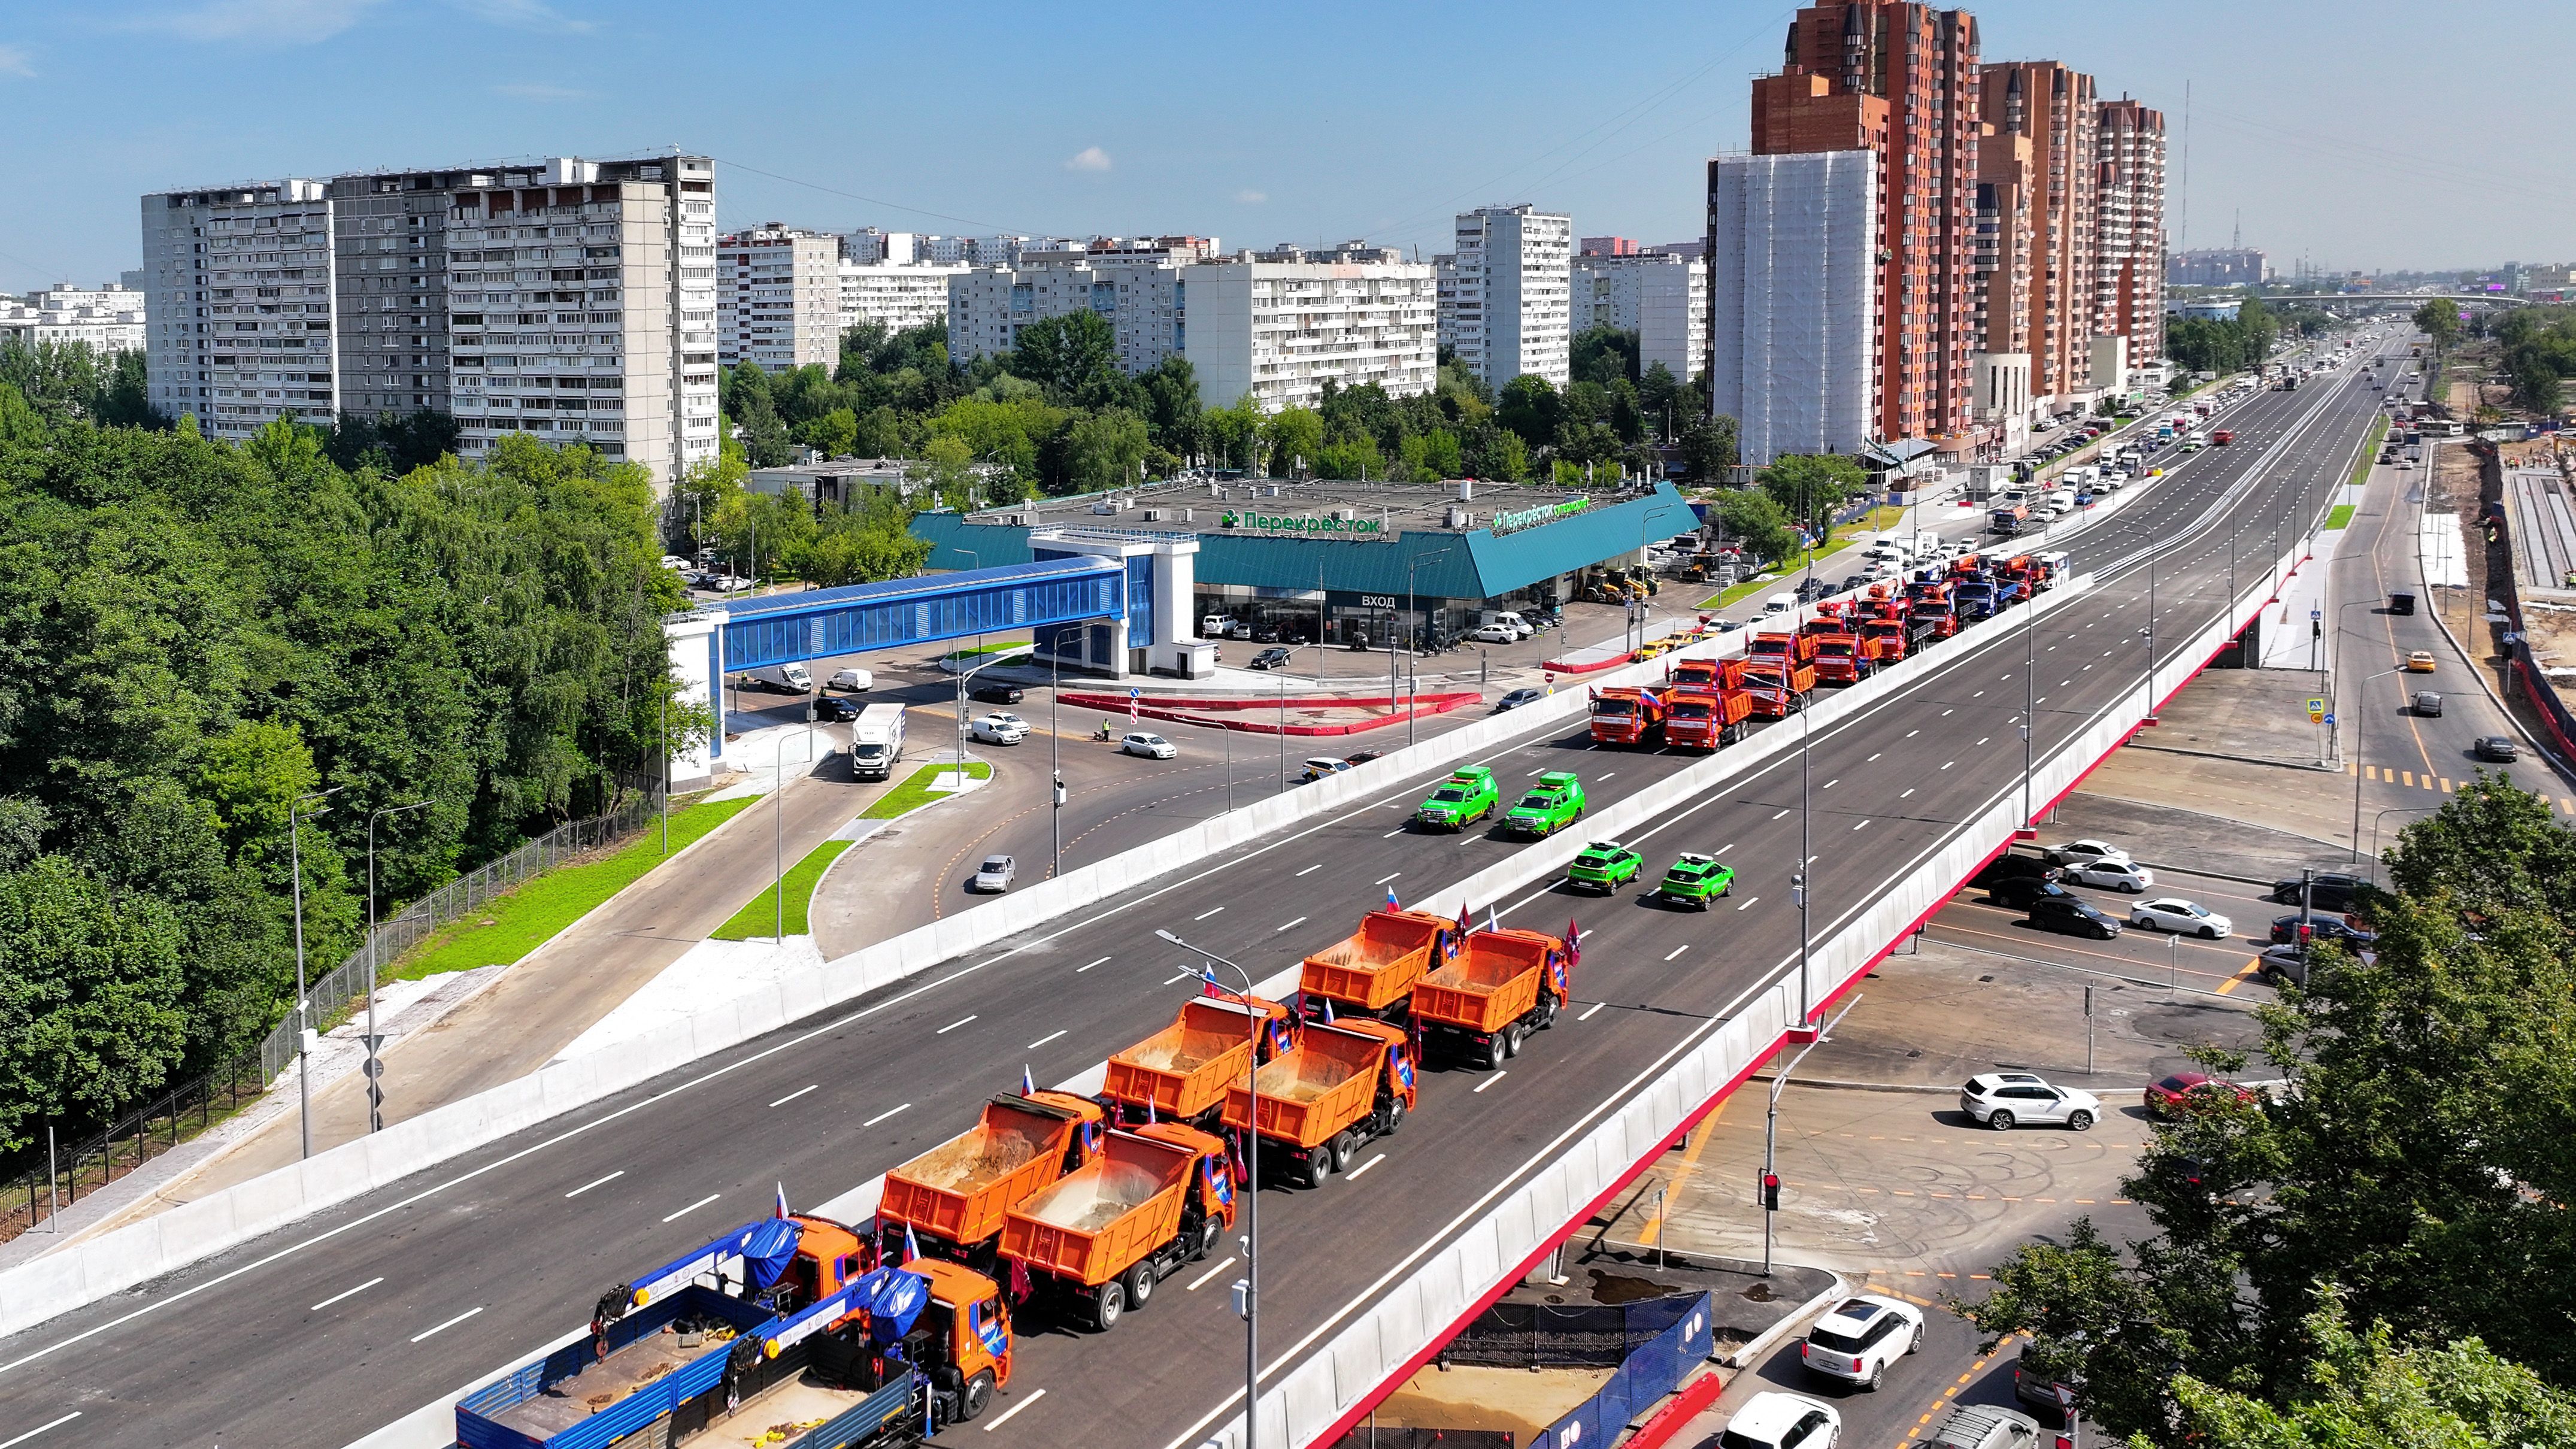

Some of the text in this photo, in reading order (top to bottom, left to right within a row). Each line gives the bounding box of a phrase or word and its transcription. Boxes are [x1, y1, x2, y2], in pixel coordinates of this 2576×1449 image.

[1244, 511, 1380, 534] Перекрёсток
[1503, 498, 1590, 531] Перекрёсток супермаркет
[1362, 595, 1395, 610] ВХОД
